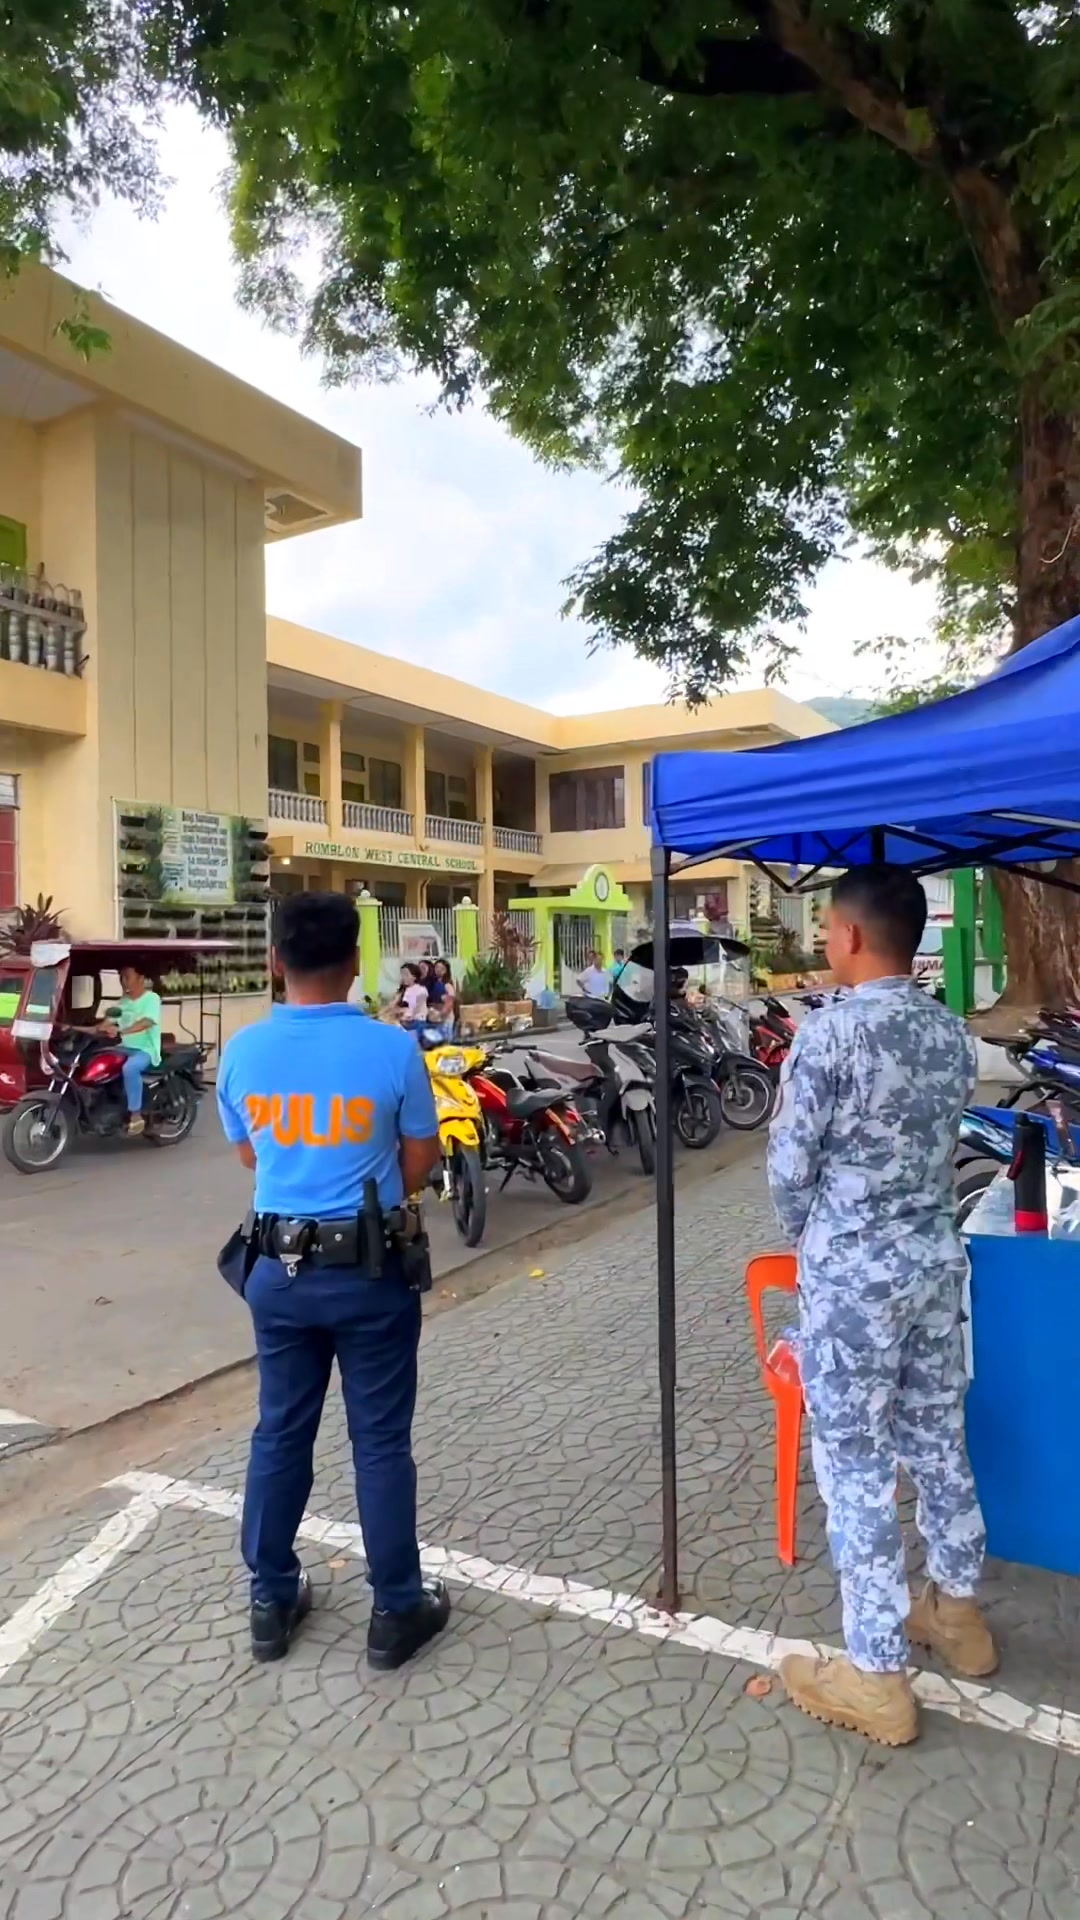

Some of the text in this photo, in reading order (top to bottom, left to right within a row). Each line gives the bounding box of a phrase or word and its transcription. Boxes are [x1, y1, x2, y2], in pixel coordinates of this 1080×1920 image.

[305, 842, 478, 870] ROMBLON WEST CENTRAL SCHOOL
[245, 1094, 374, 1147] PULIS
